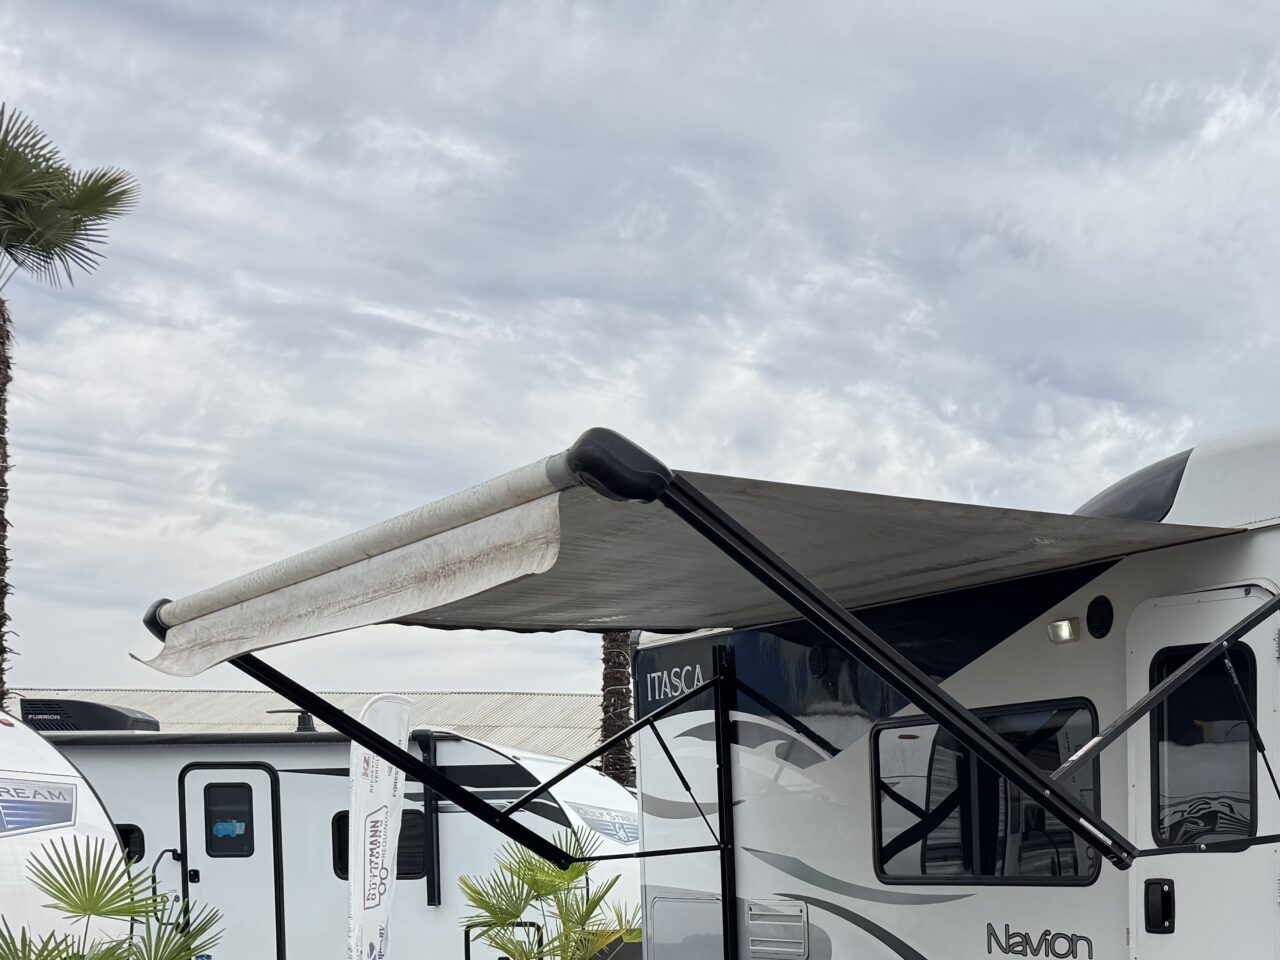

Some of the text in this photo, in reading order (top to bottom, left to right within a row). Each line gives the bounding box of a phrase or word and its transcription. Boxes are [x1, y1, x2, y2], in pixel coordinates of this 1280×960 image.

[646, 664, 704, 701] ITASCA
[0, 786, 67, 801] REAM
[987, 922, 1093, 960] Navion
